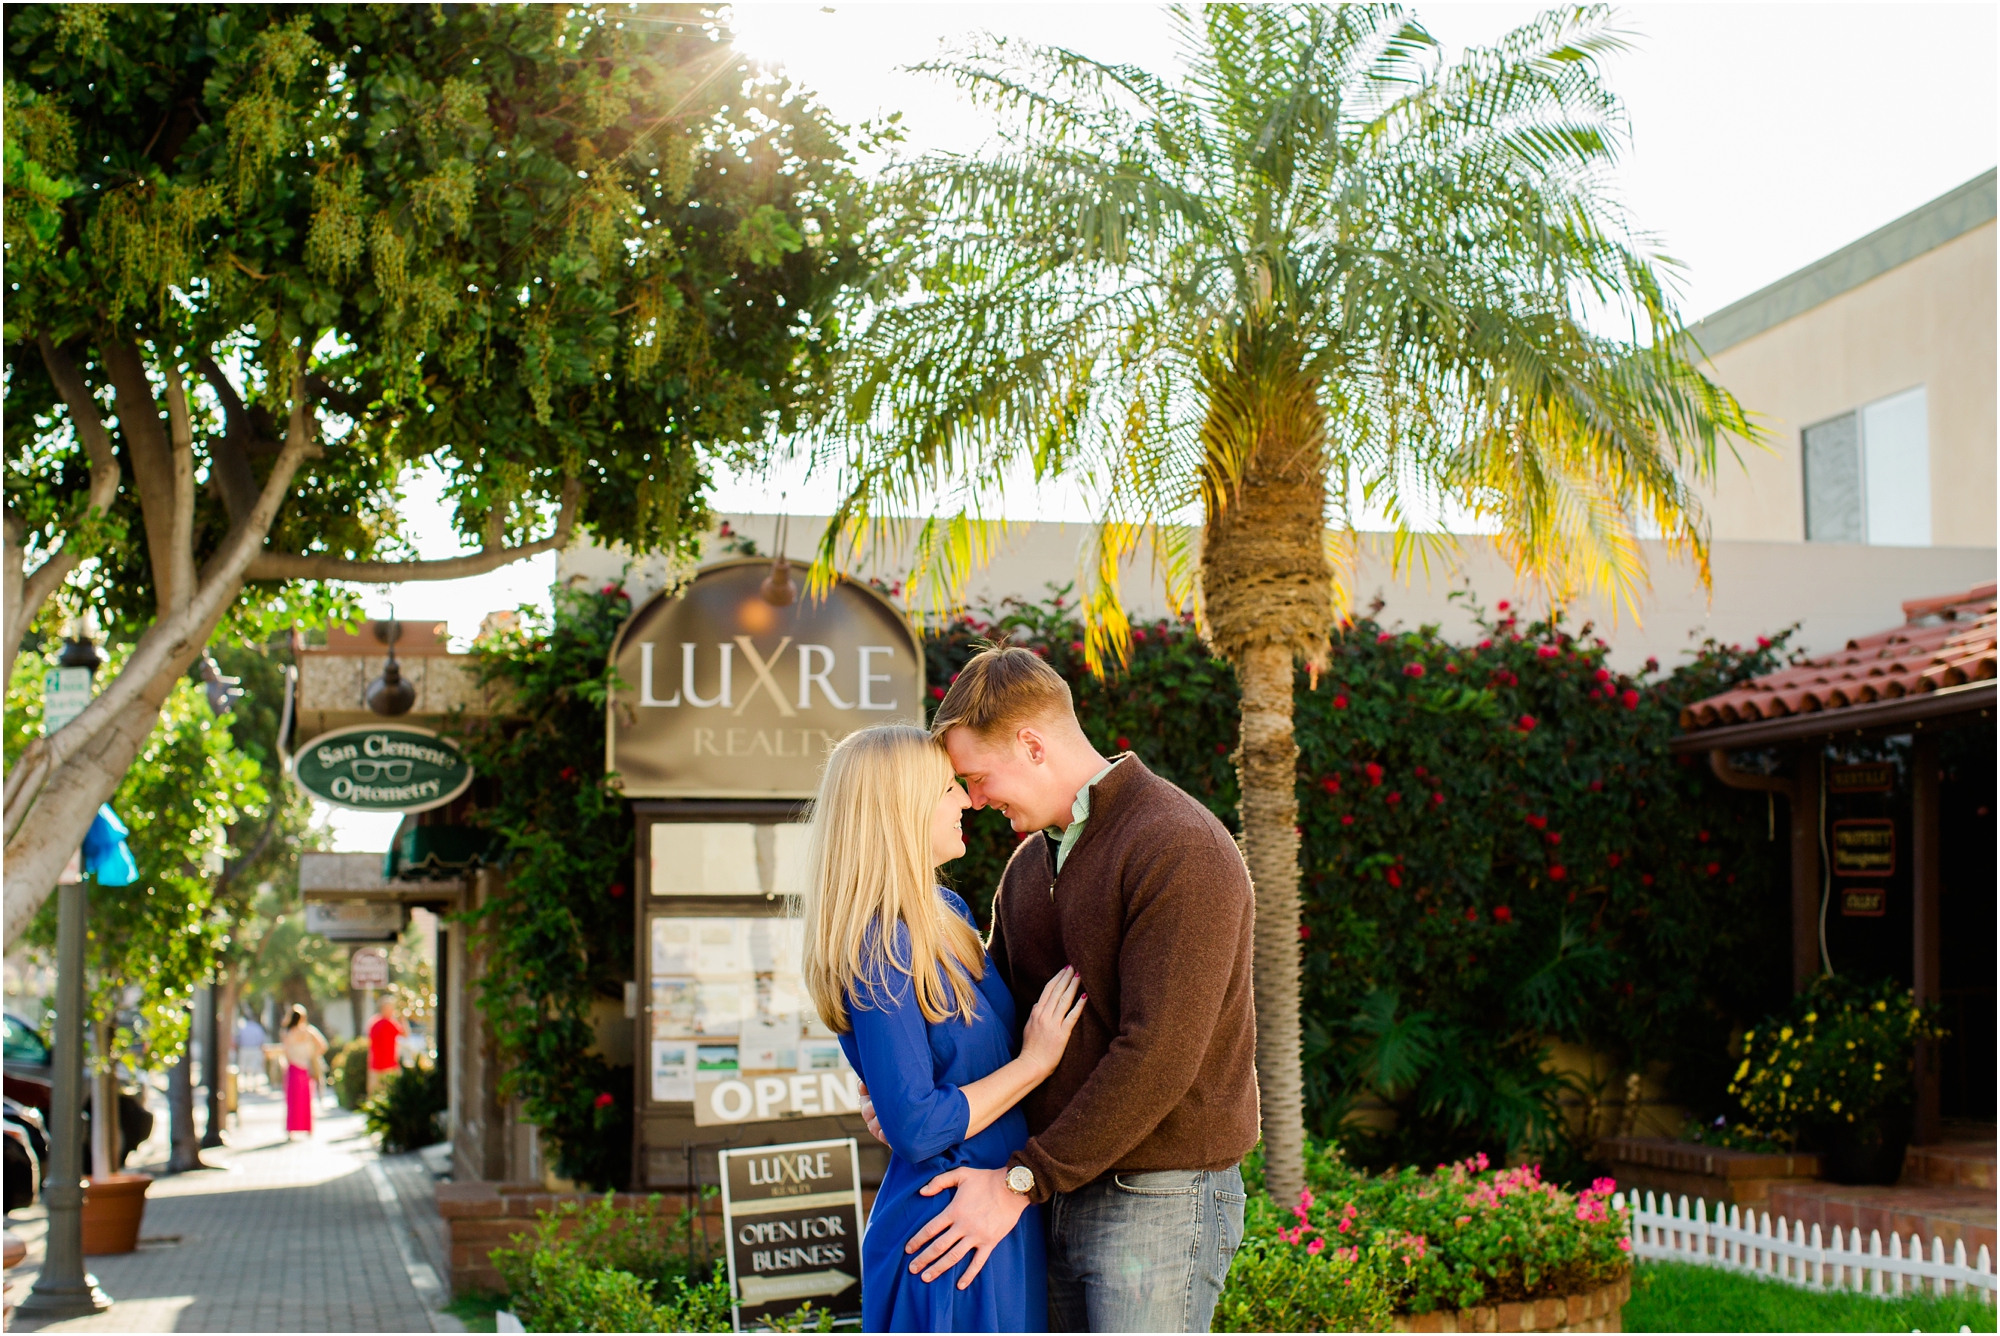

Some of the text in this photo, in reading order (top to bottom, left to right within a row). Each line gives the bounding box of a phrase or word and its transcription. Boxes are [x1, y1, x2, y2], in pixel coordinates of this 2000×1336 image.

[639, 635, 898, 717] LUXRE
[317, 734, 457, 770] San Clemente
[331, 776, 440, 803] Optometry
[711, 1072, 860, 1121] OPEN
[748, 1152, 833, 1185] LUXRE
[739, 1216, 847, 1246] OPEN FOR
[752, 1243, 846, 1272] BUSINESS
